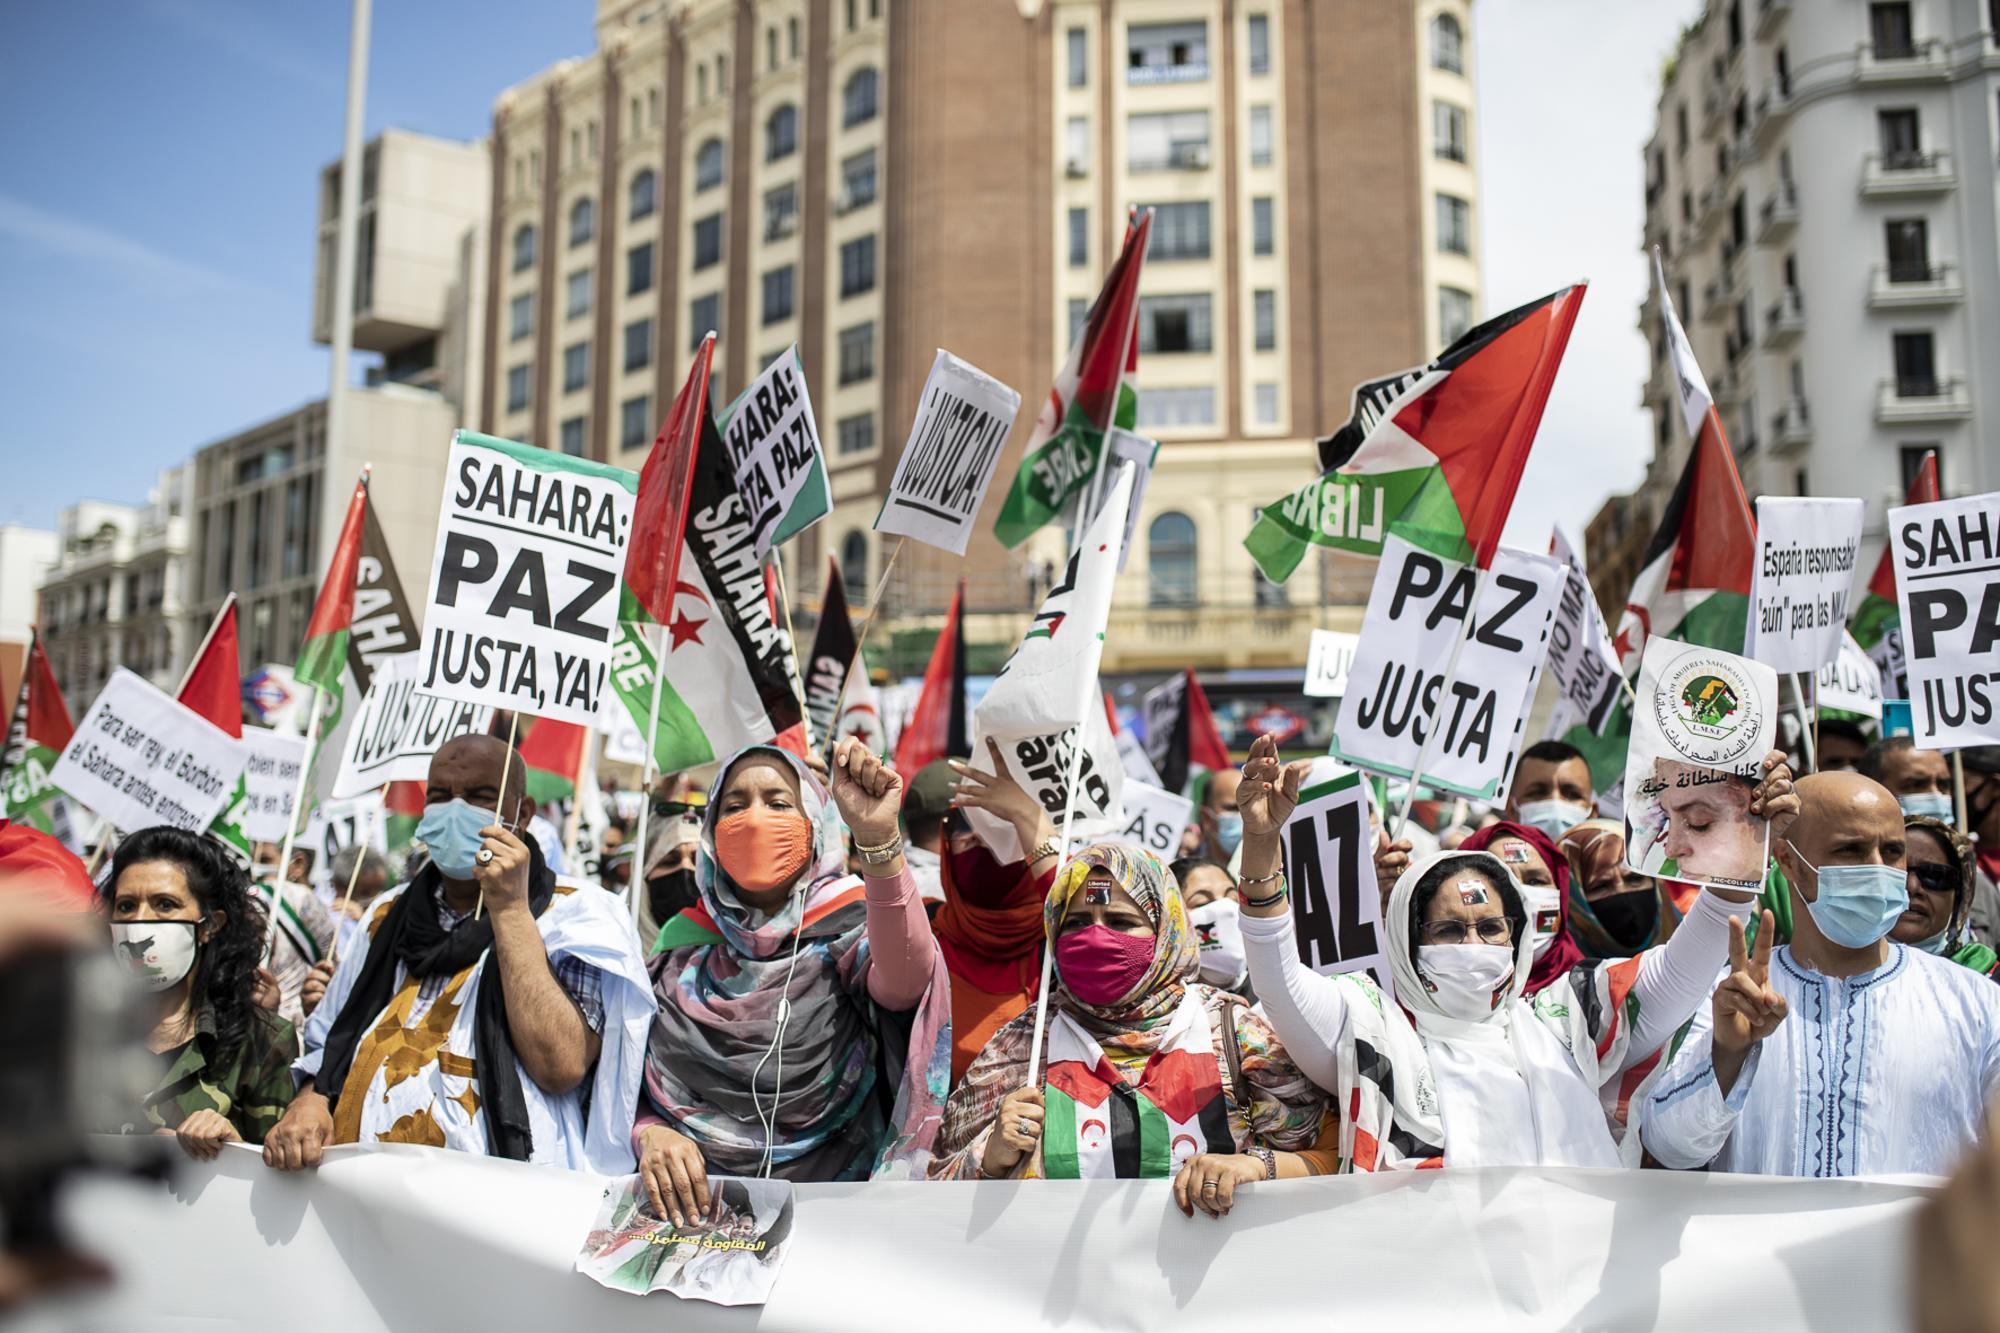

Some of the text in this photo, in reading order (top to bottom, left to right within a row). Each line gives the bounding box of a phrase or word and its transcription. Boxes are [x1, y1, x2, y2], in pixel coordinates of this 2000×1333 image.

[728, 367, 798, 472] HARA:
[770, 409, 817, 490] PAZ!
[455, 456, 628, 548] SAHARA:
[1902, 511, 2000, 570] SAH
[434, 530, 617, 643] PAZ
[1388, 551, 1538, 653] PAZ
[1763, 541, 1802, 586] España
[1791, 602, 1814, 640] para
[1817, 593, 1829, 628] las
[93, 703, 124, 739] Para
[1357, 661, 1497, 764] JUSTA
[1280, 800, 1379, 970] AZ
